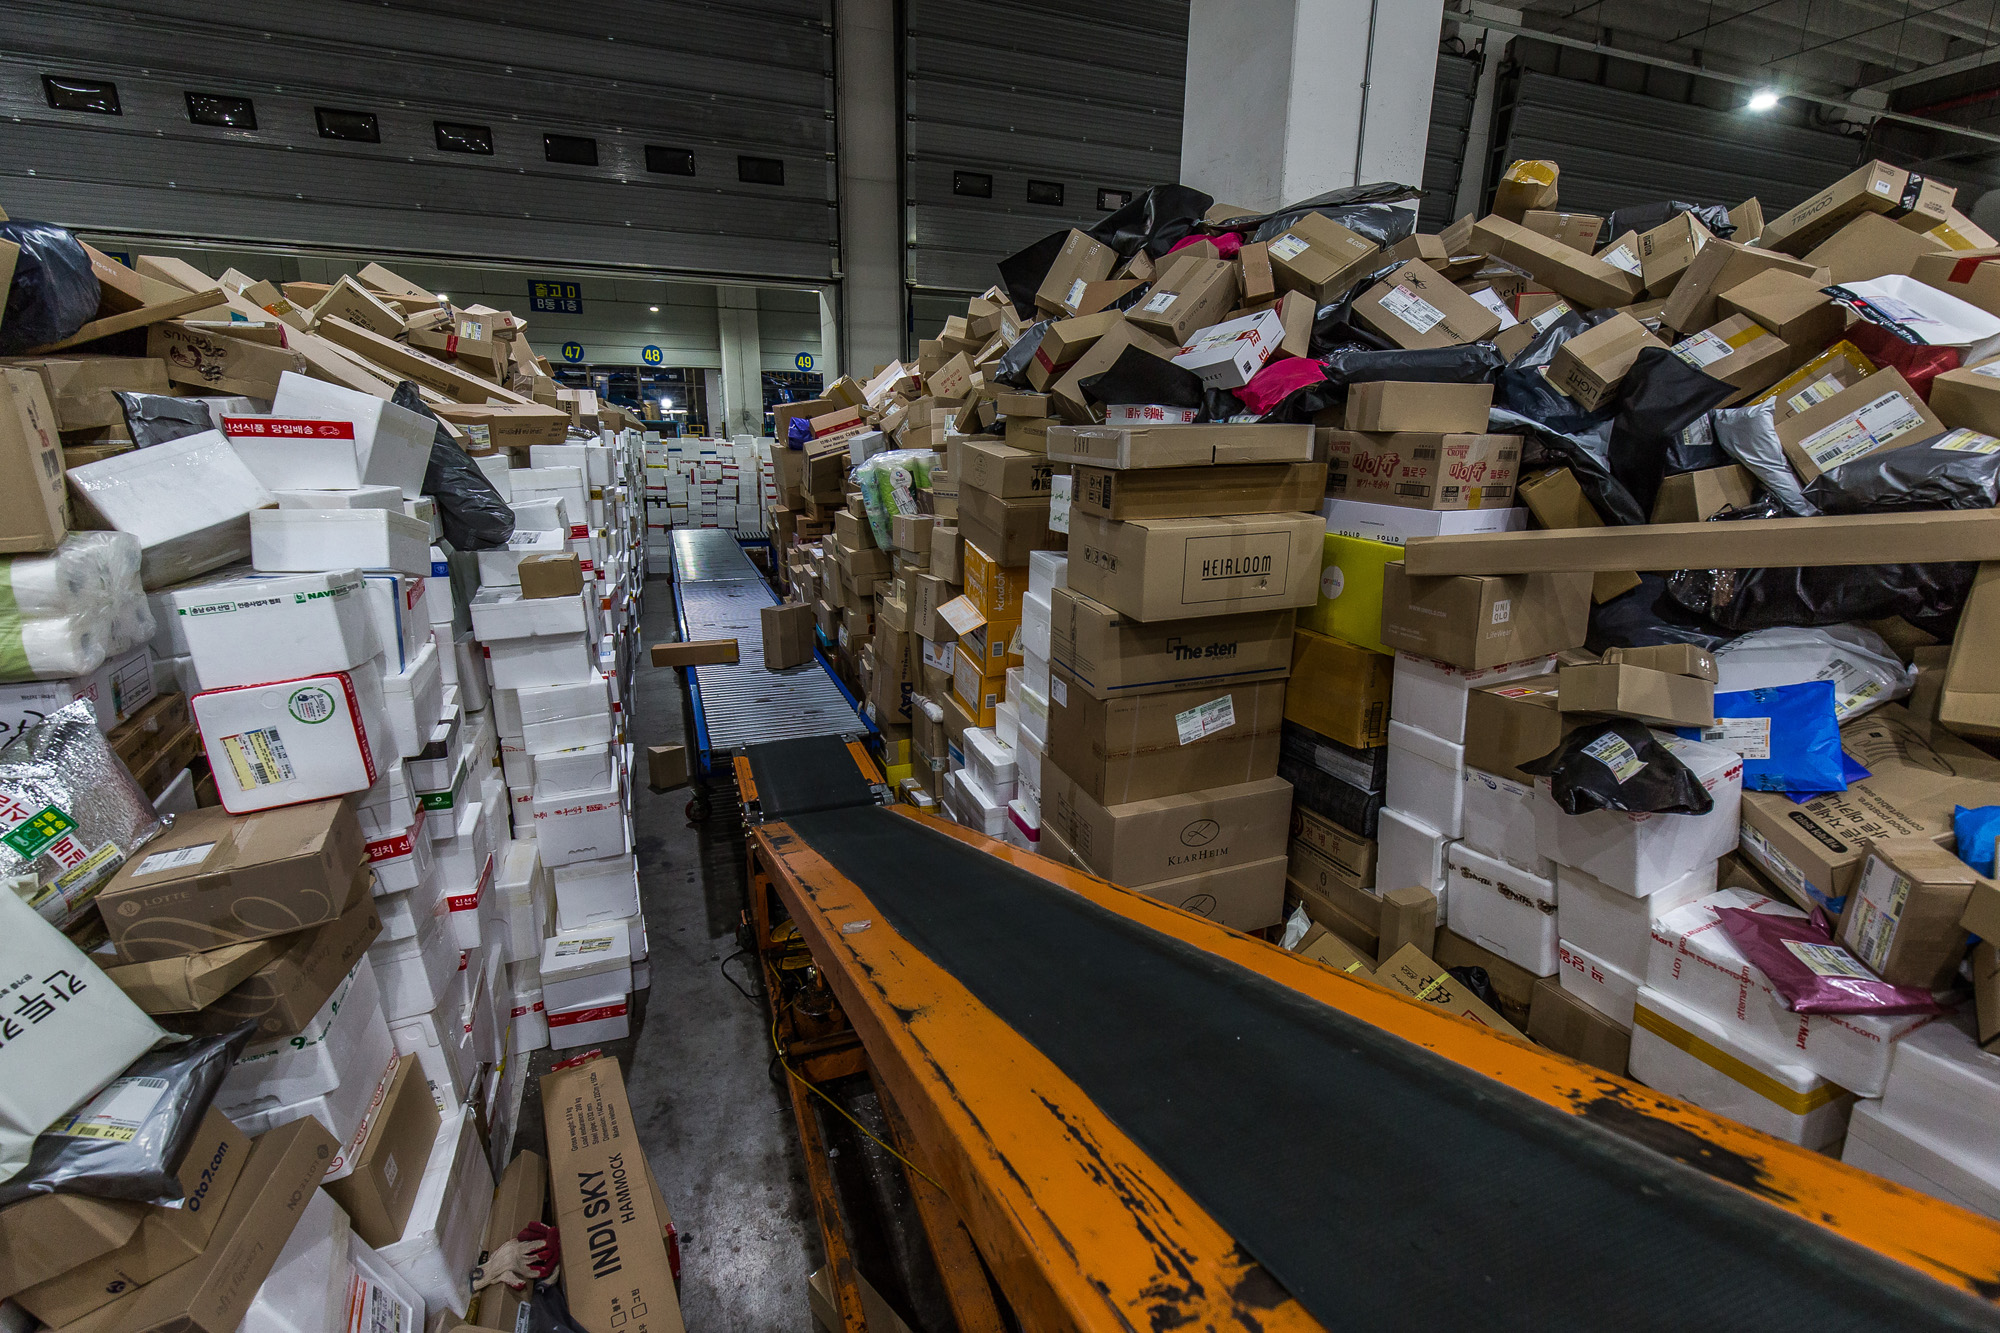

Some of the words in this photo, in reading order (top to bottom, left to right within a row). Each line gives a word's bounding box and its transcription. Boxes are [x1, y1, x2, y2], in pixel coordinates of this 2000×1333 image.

[1792, 197, 1833, 226] COWELL
[534, 282, 562, 299] 출고
[566, 285, 576, 299] D
[537, 299, 555, 311] B동
[560, 300, 577, 312] 1층
[564, 345, 581, 359] 47
[644, 348, 661, 363] 48
[797, 355, 813, 369] 49
[271, 424, 315, 435] 당일배송
[1402, 465, 1428, 478] 필로우
[1490, 469, 1511, 480] 필로우
[1376, 534, 1400, 543] SOLID
[1202, 555, 1272, 578] HEIRLOOM
[993, 571, 1006, 613] kindoh
[1495, 602, 1509, 612] UNI
[1494, 611, 1509, 622] QLO
[1486, 628, 1513, 640] LifeWear
[1173, 644, 1203, 662] The
[1204, 641, 1238, 658] sten
[1857, 783, 1875, 798] seat
[1805, 801, 1845, 830] 자세를
[1875, 796, 1925, 832] comfortable
[1887, 816, 1911, 837] Good
[371, 845, 395, 858] 김치
[145, 891, 191, 906] LOTTE
[1650, 931, 1675, 949] Mart
[290, 1036, 307, 1050] 9
[592, 1132, 600, 1145] Steel
[612, 1125, 620, 1139] Made
[571, 1137, 579, 1152] Gross
[581, 1136, 589, 1148] Load
[188, 1141, 229, 1213] Oto7.com
[578, 1170, 610, 1219] SKY
[608, 1152, 636, 1224] HAMMOCK
[587, 1218, 622, 1280] INDI
